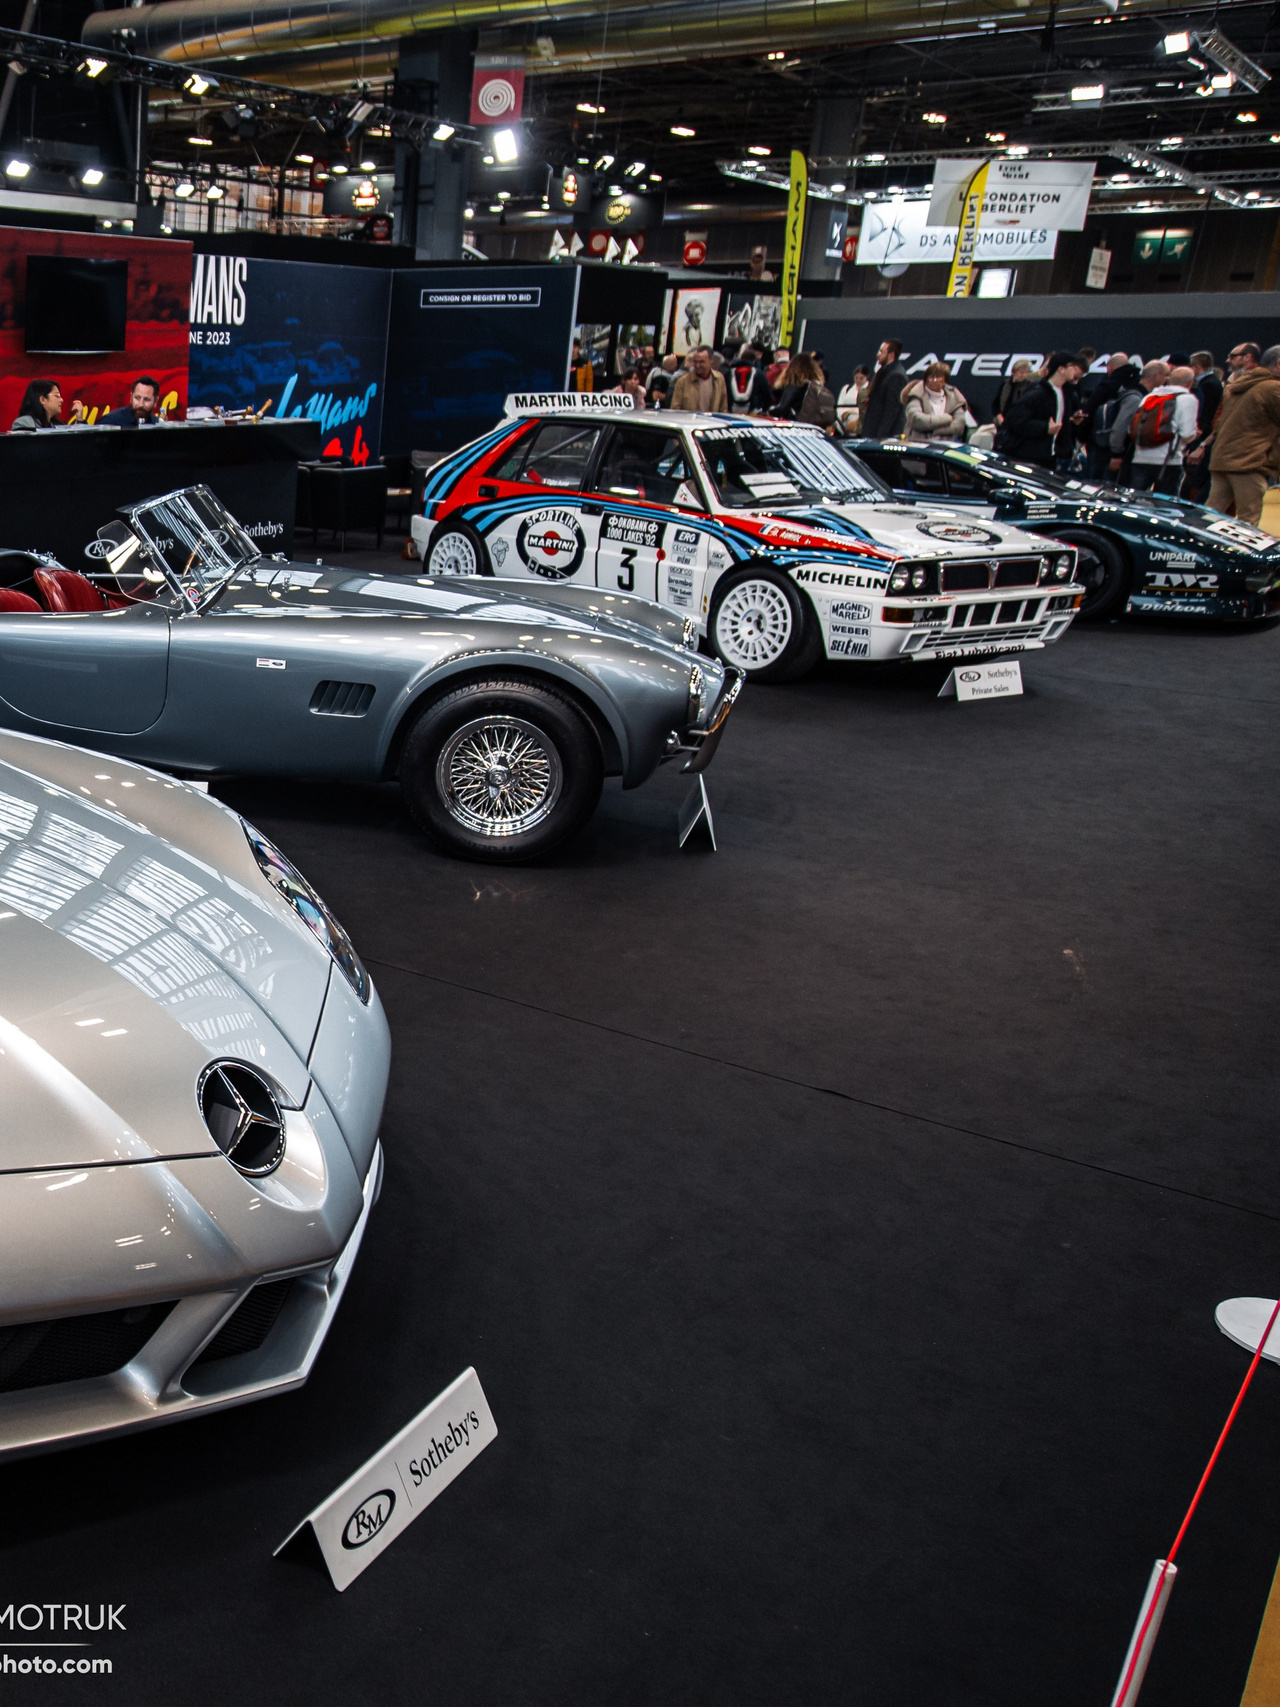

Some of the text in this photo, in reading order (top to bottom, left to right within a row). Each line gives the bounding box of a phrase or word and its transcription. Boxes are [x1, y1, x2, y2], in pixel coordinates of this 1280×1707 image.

[981, 204, 1036, 214] BERLIET
[919, 230, 1048, 247] DS AMOBILES
[189, 254, 247, 326] MANS
[429, 295, 460, 303] CONSIGN
[472, 294, 507, 302] REGISTER
[519, 293, 532, 301] BID
[206, 331, 231, 346] 2023
[514, 394, 632, 408] MARTINI RACING
[243, 520, 284, 539] Sotheby's
[525, 509, 581, 535] SPORTLINE
[606, 527, 623, 540] 1000
[622, 529, 644, 544] LAKES
[678, 531, 696, 543] ERG
[529, 536, 574, 551] MARTINI
[1149, 551, 1198, 562] UNIPART
[617, 546, 638, 593] 3
[796, 569, 888, 590] MICHELIN
[1145, 571, 1220, 589] TWR
[1141, 589, 1217, 598] RACING
[1140, 602, 1207, 613] DUNLOP
[832, 624, 869, 636] WEBER
[987, 667, 1018, 679] Sotheby's
[971, 684, 1010, 696] Private Sales
[409, 1410, 480, 1487] Sotheby's
